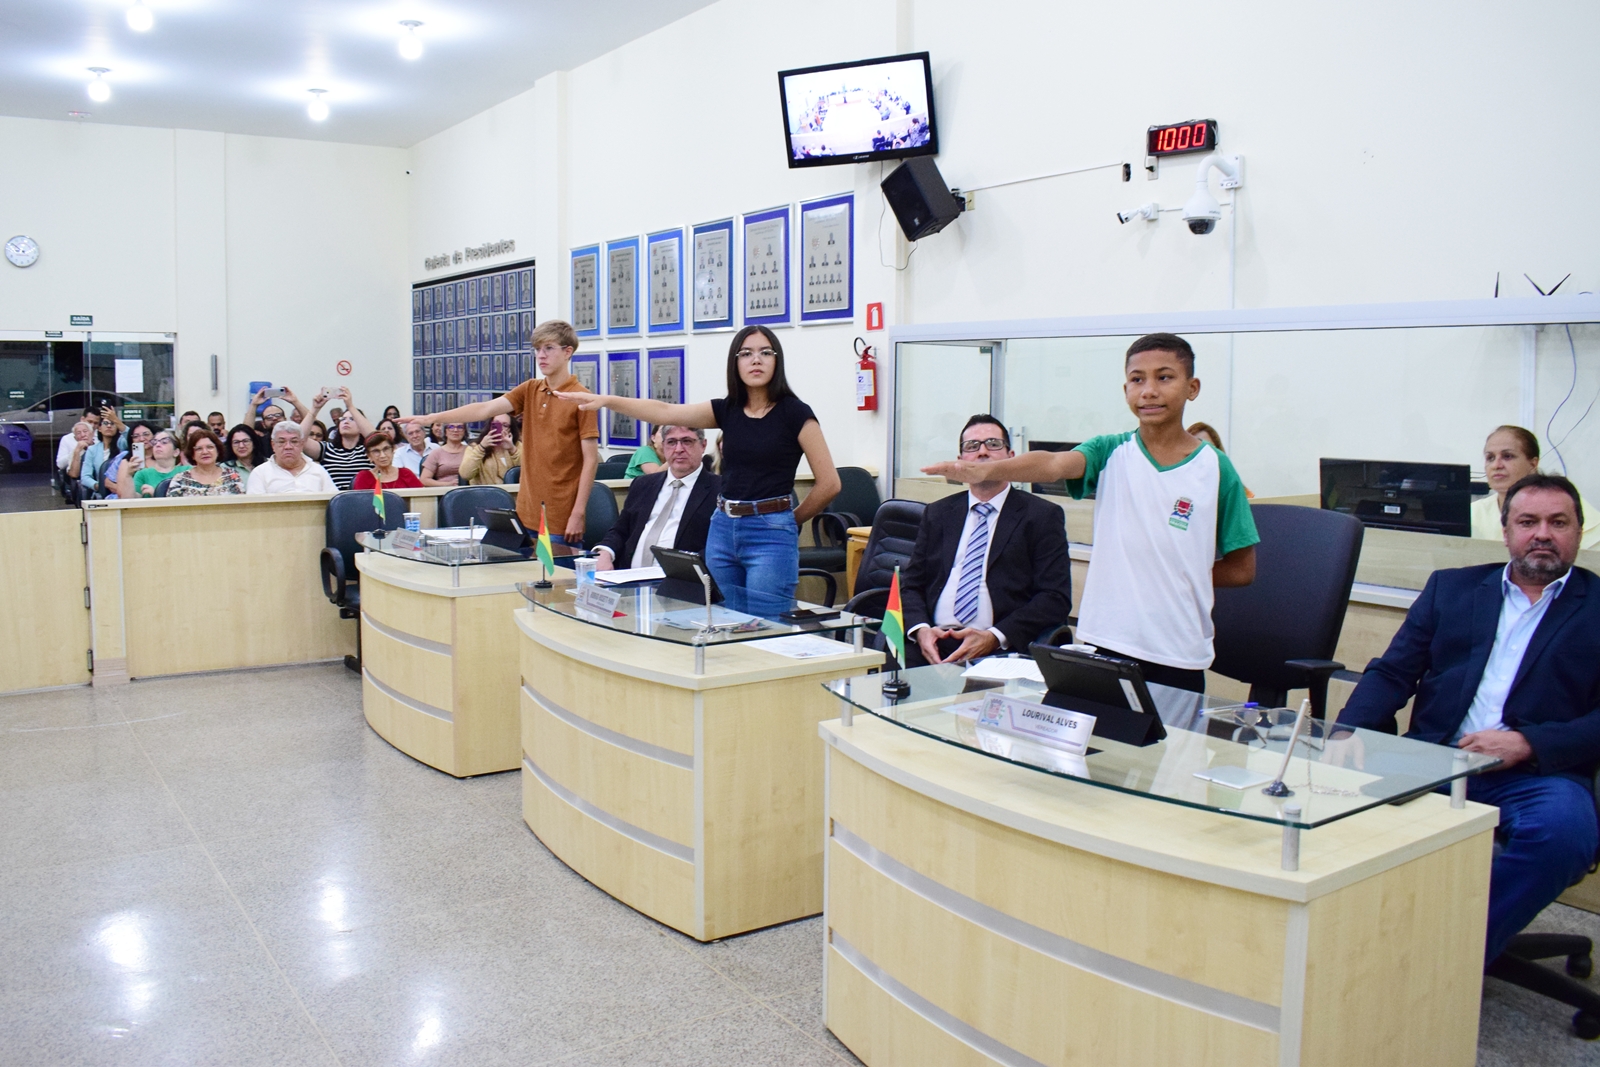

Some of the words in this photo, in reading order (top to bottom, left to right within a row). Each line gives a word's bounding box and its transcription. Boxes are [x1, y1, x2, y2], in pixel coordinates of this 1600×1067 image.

[1158, 123, 1206, 151] 1000
[425, 253, 450, 271] Galeria
[453, 251, 462, 265] de
[465, 240, 515, 261] Presidentes
[1022, 709, 1055, 723] LOURIVAL
[1055, 717, 1077, 729] ALVES
